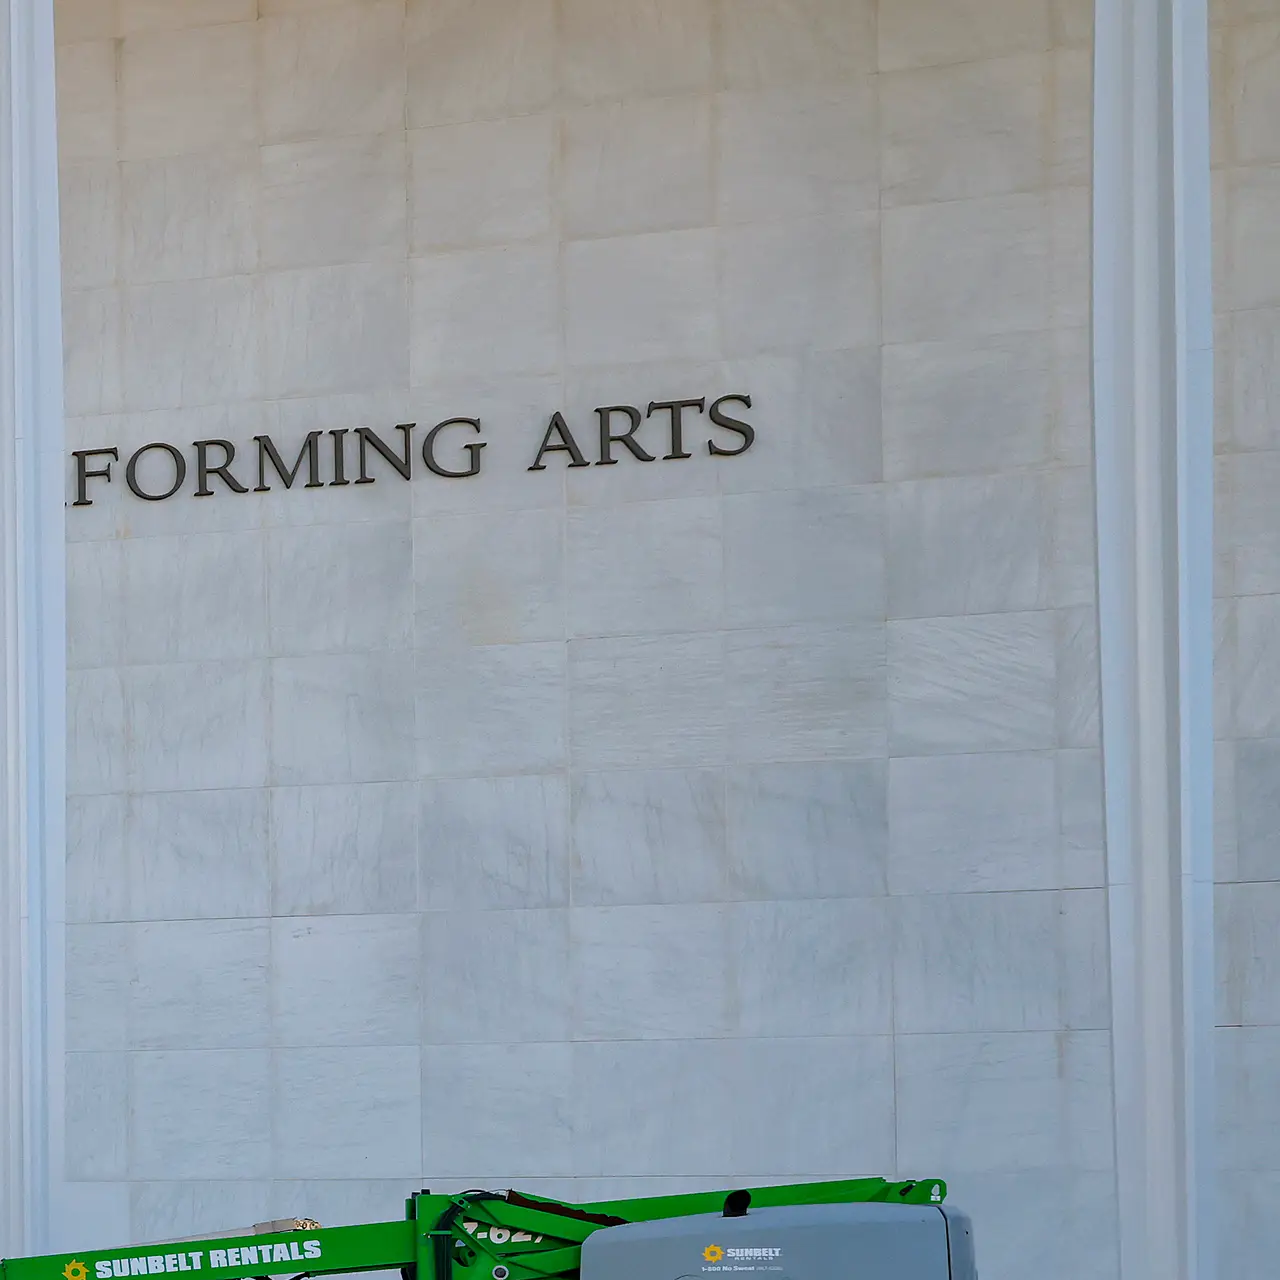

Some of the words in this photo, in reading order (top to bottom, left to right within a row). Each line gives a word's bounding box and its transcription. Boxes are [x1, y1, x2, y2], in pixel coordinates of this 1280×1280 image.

[528, 394, 755, 472] ARTS
[95, 1251, 203, 1279] SUNBELT
[209, 1240, 321, 1268] RENTALS
[726, 1247, 781, 1257] SUNBELT
